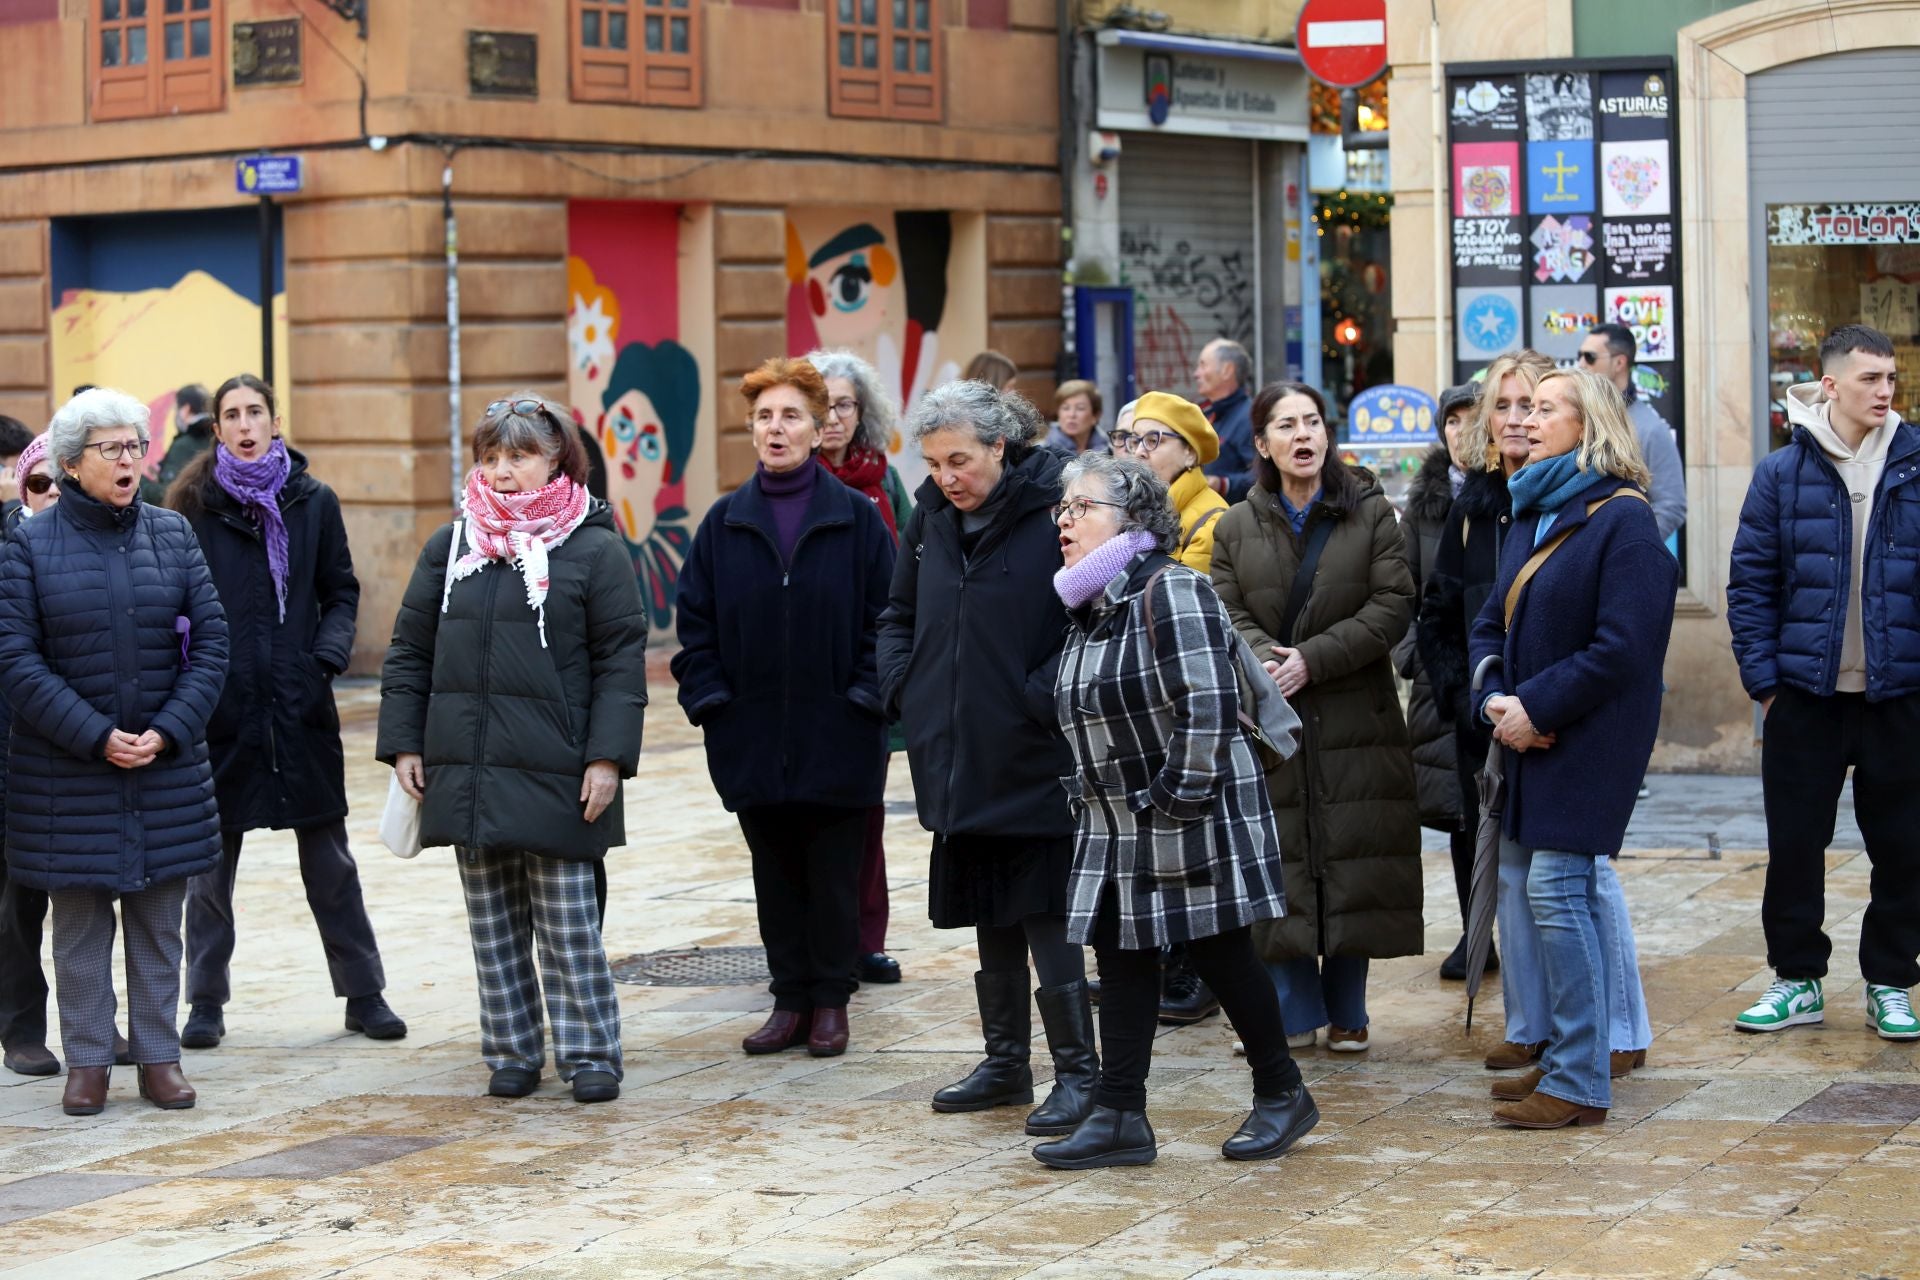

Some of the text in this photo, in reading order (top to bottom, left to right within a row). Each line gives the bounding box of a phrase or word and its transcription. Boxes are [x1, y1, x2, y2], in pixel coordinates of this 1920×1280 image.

[1599, 96, 1668, 113] ASTURIAS
[1454, 218, 1510, 235] ESTOY
[1603, 222, 1671, 234] Esto no es
